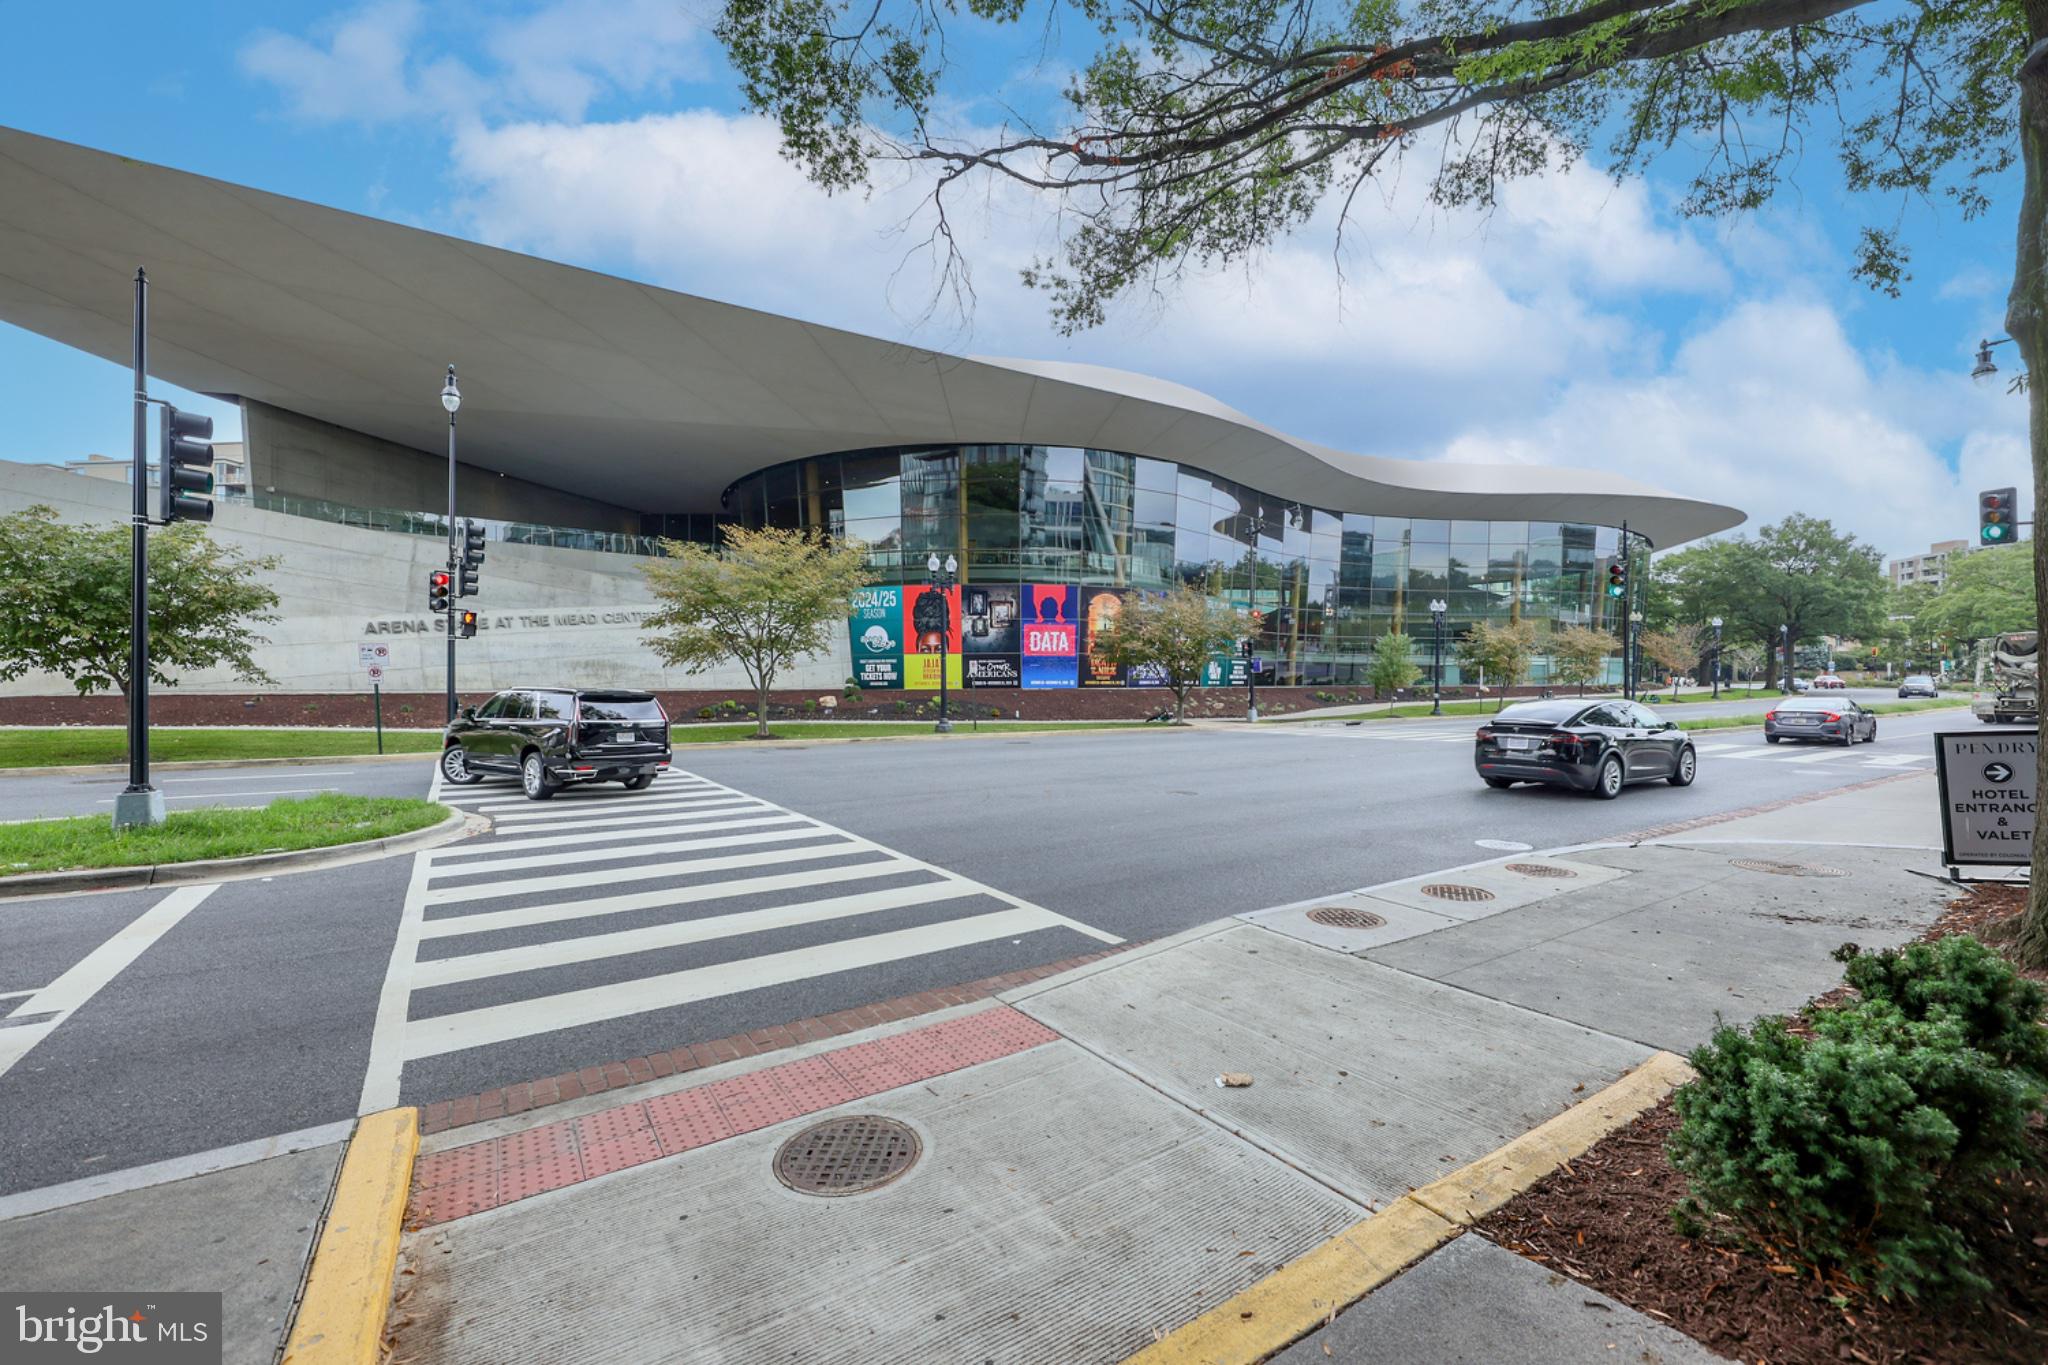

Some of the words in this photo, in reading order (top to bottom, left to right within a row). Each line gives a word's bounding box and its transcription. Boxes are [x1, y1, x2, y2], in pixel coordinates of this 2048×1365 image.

[852, 591, 897, 607] 2024/25
[863, 608, 886, 619] SEASON
[364, 620, 429, 635] ARENA
[434, 617, 489, 632] STE
[495, 616, 513, 629] AT
[519, 615, 550, 628] THE
[555, 613, 597, 626] MEAD
[1029, 631, 1069, 652] DATA
[1956, 742, 2037, 754] PENDRY
[1972, 790, 2030, 799] HOTEL
[1955, 803, 2036, 813] ENTRANC
[1997, 817, 2008, 827] &
[1977, 830, 2032, 841] VALET
